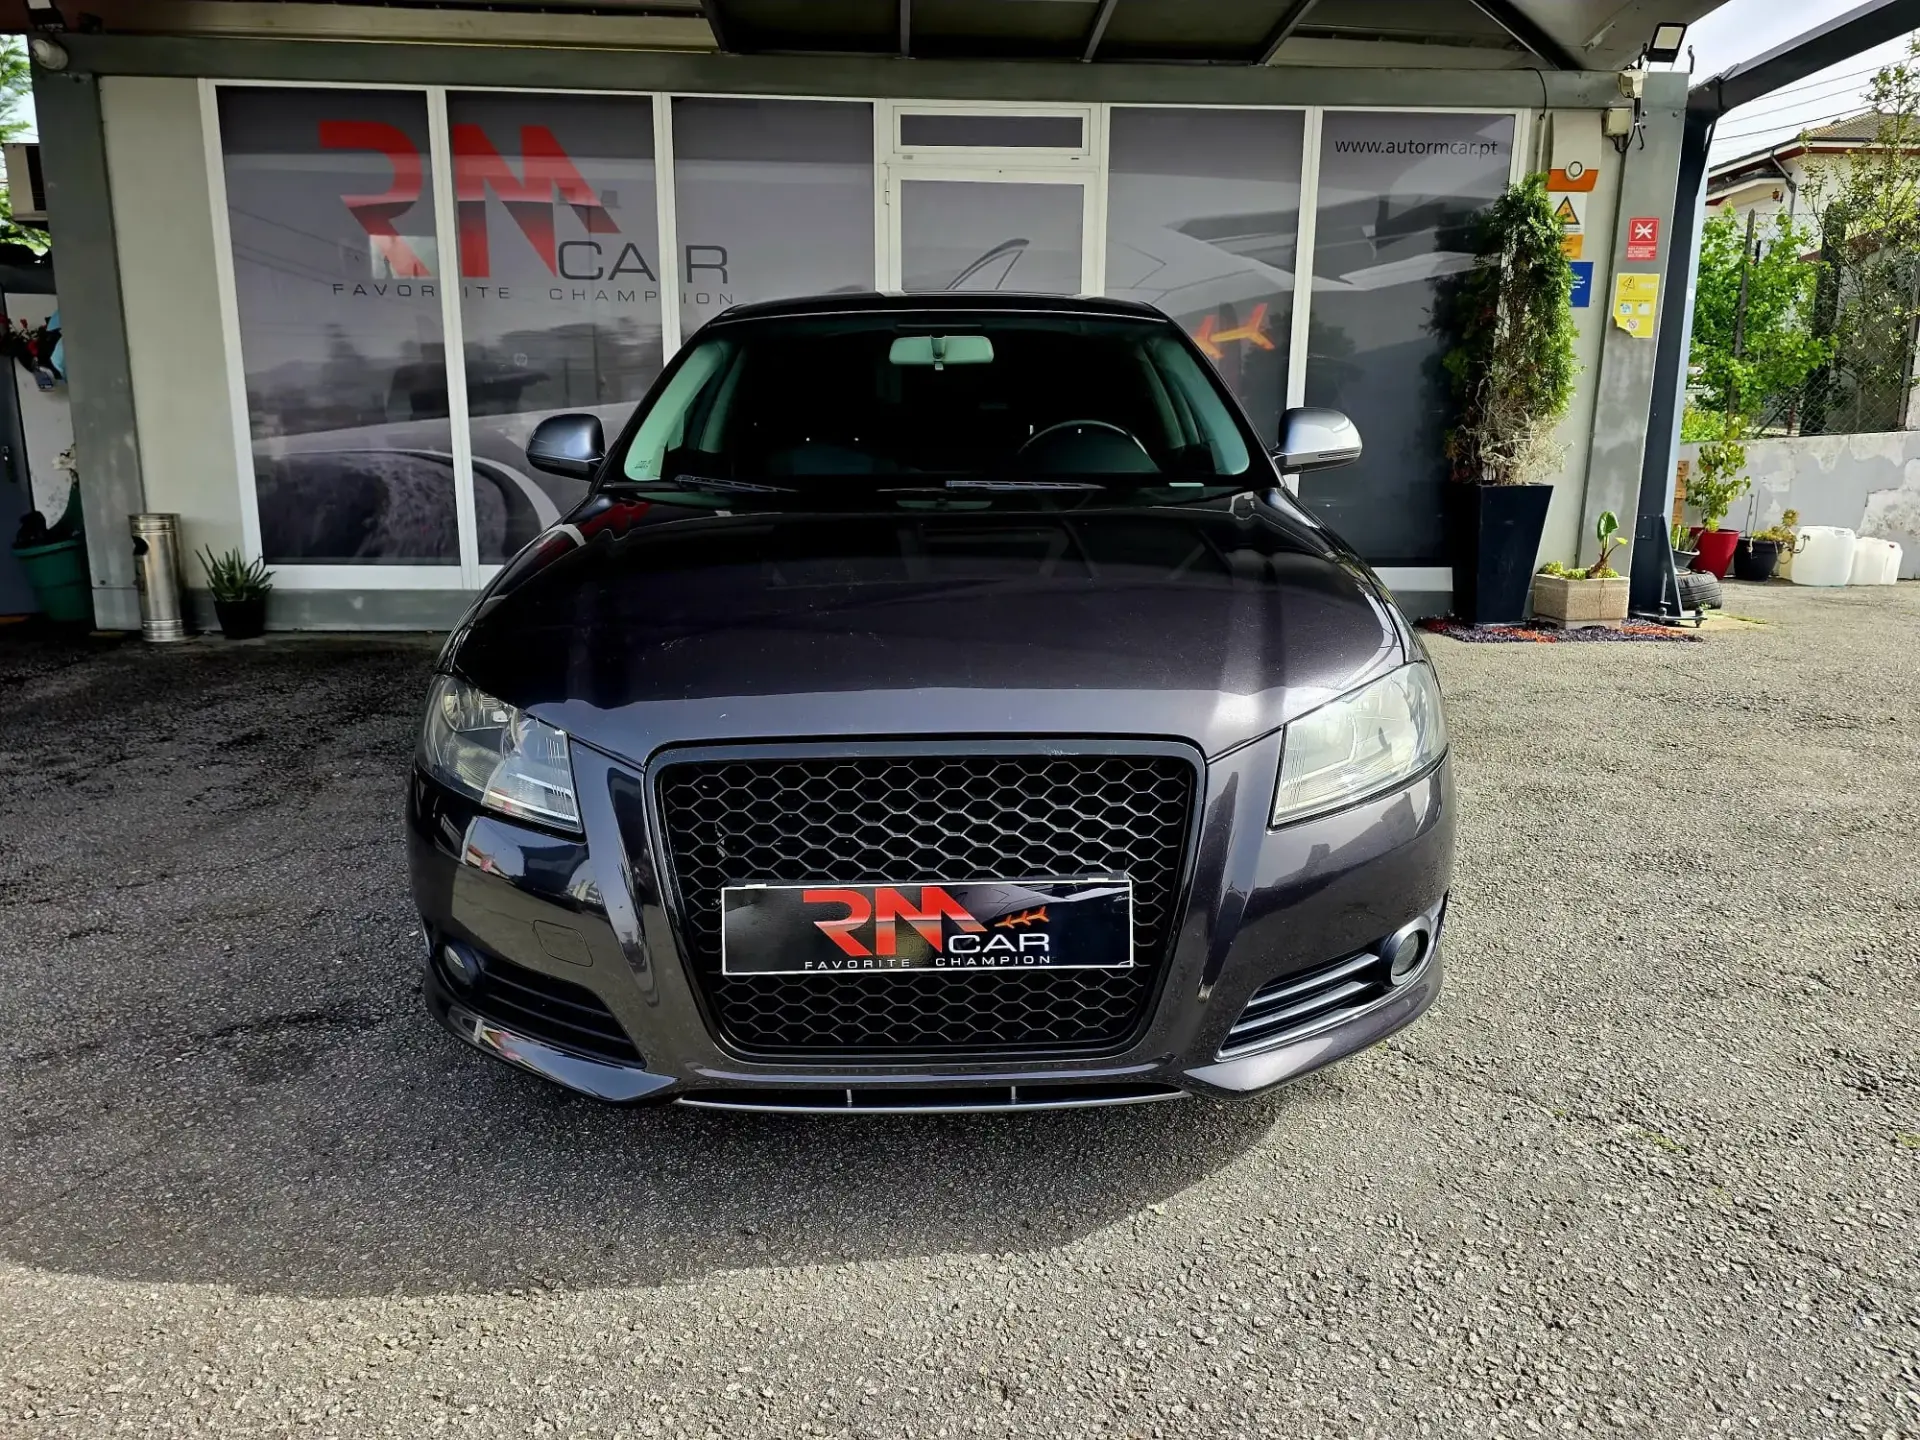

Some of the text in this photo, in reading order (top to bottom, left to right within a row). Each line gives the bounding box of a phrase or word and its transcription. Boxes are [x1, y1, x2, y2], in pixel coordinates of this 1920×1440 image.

[1335, 139, 1498, 159] www.autormcar.pt
[318, 119, 622, 279] RM
[558, 240, 728, 284] CAR
[332, 283, 734, 305] FAVORITE CHAMPION
[803, 886, 988, 956] RM
[948, 933, 1050, 953] CAR
[804, 955, 1051, 970] FAVORITE CHAMPION
